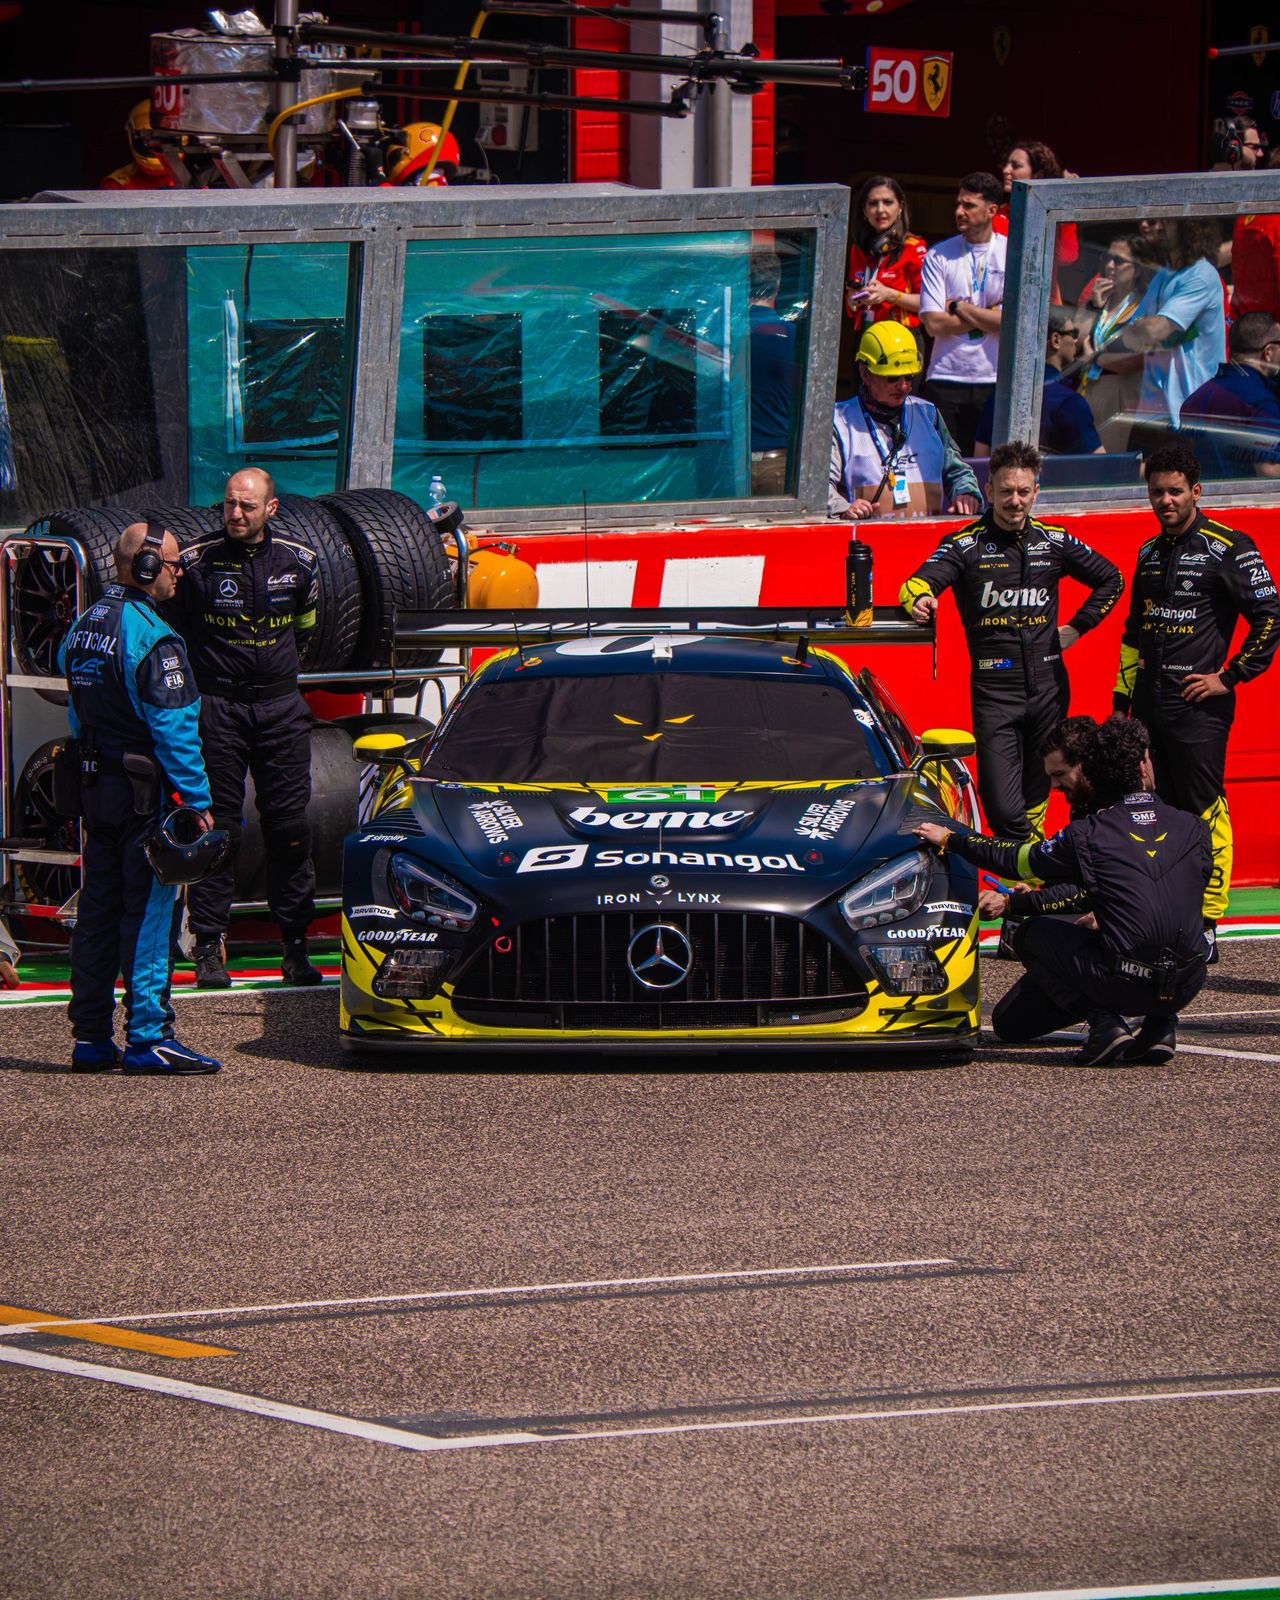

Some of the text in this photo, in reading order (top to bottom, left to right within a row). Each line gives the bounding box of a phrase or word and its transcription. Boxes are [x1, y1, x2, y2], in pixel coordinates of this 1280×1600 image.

[871, 59, 917, 104] 50
[1212, 541, 1227, 553] OMP
[1180, 552, 1210, 562] WEC
[267, 574, 297, 585] WEC
[92, 607, 109, 617] OMP
[204, 613, 236, 627] IRON
[981, 616, 1007, 626] IRON
[1166, 625, 1194, 634] LYNX
[67, 630, 117, 655] OFFICIAL
[162, 659, 179, 669] OMP
[979, 660, 994, 668] OMP
[165, 674, 184, 689] FIA
[622, 789, 704, 801] 61
[493, 804, 525, 830] SILVER
[800, 803, 831, 828] SILVER
[820, 799, 856, 833] ARROWS
[1132, 812, 1156, 820] OMP
[472, 808, 510, 845] ARROWS
[593, 849, 806, 873] Sonangol
[597, 892, 721, 905] IRON LYNX
[353, 906, 392, 916] RAVENOL
[931, 903, 969, 912] RAVENOL
[1042, 901, 1065, 911] IRON
[357, 928, 439, 944] GOODYEAR
[887, 924, 966, 941] GOODYEAR
